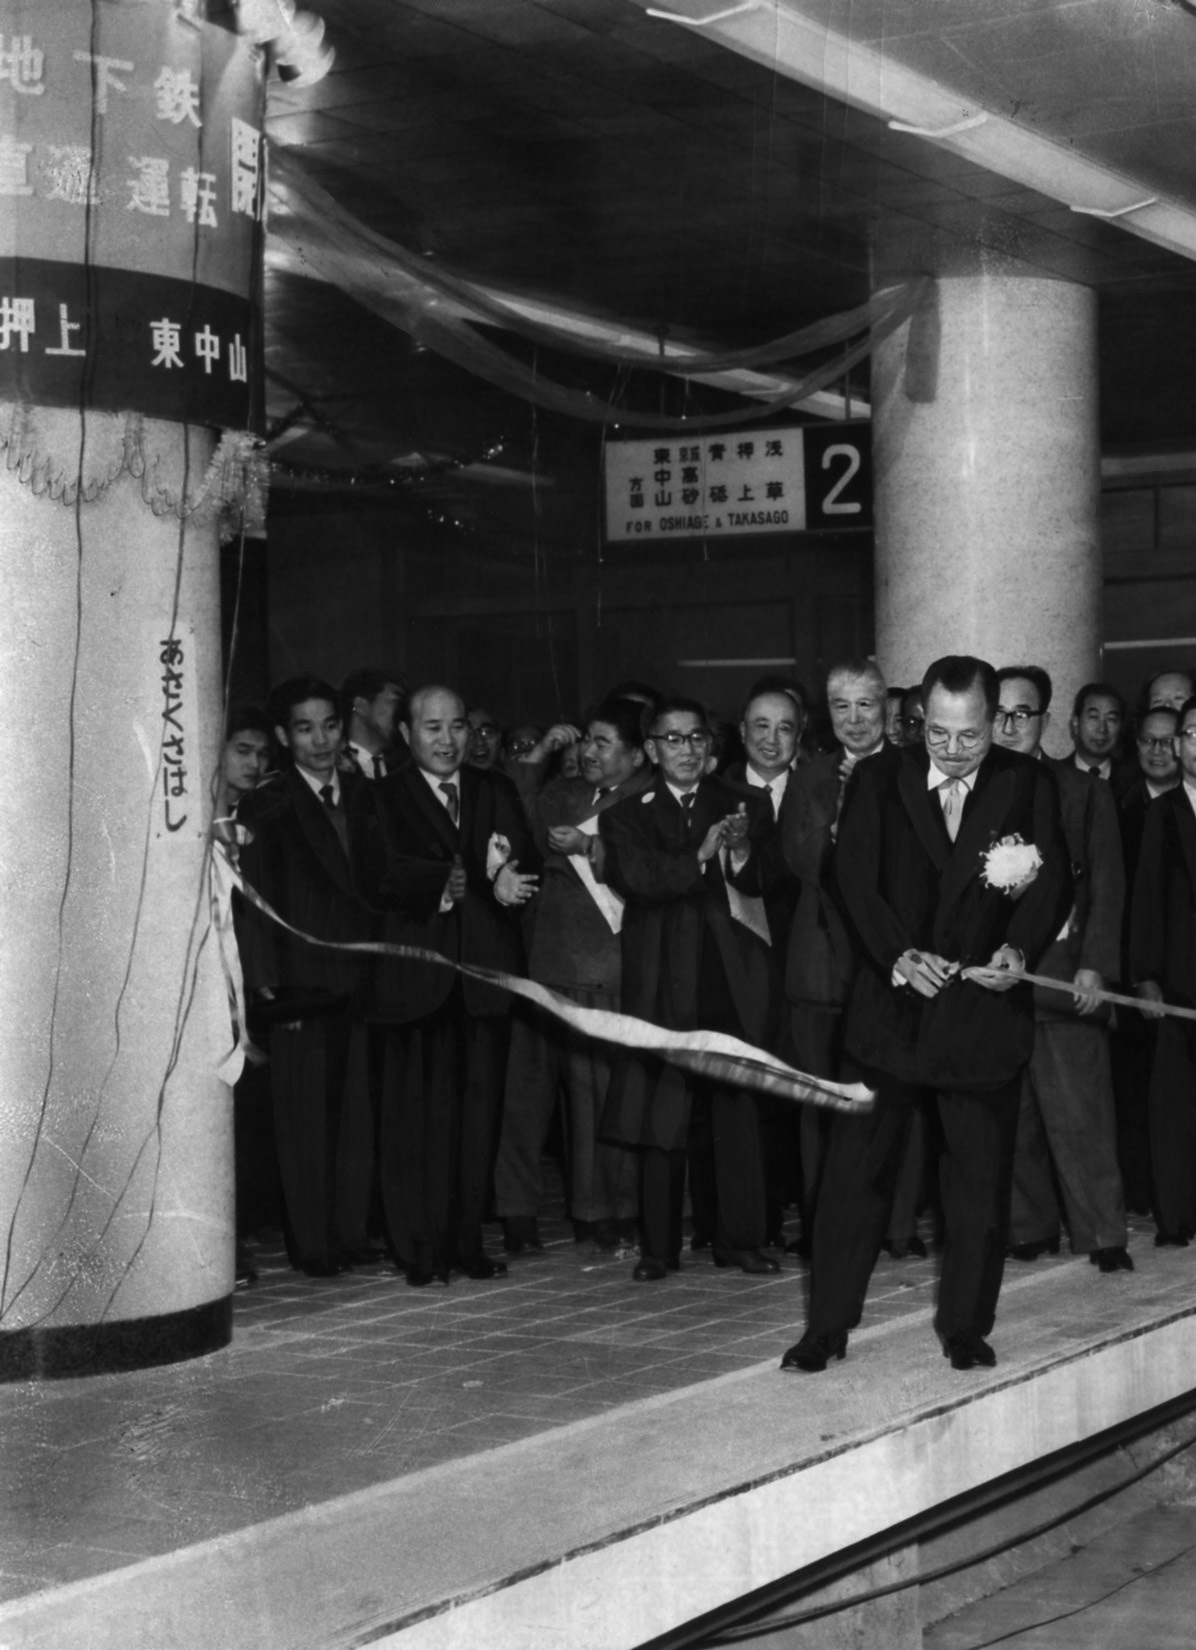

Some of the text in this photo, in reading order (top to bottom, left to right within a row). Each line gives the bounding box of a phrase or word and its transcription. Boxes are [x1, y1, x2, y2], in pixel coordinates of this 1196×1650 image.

[149, 317, 247, 383] 東中山
[653, 447, 672, 507] 東中山
[737, 441, 755, 502] 押上
[821, 444, 862, 515] 2
[625, 510, 790, 534] FOR OSHIAGE & TAKASAGO
